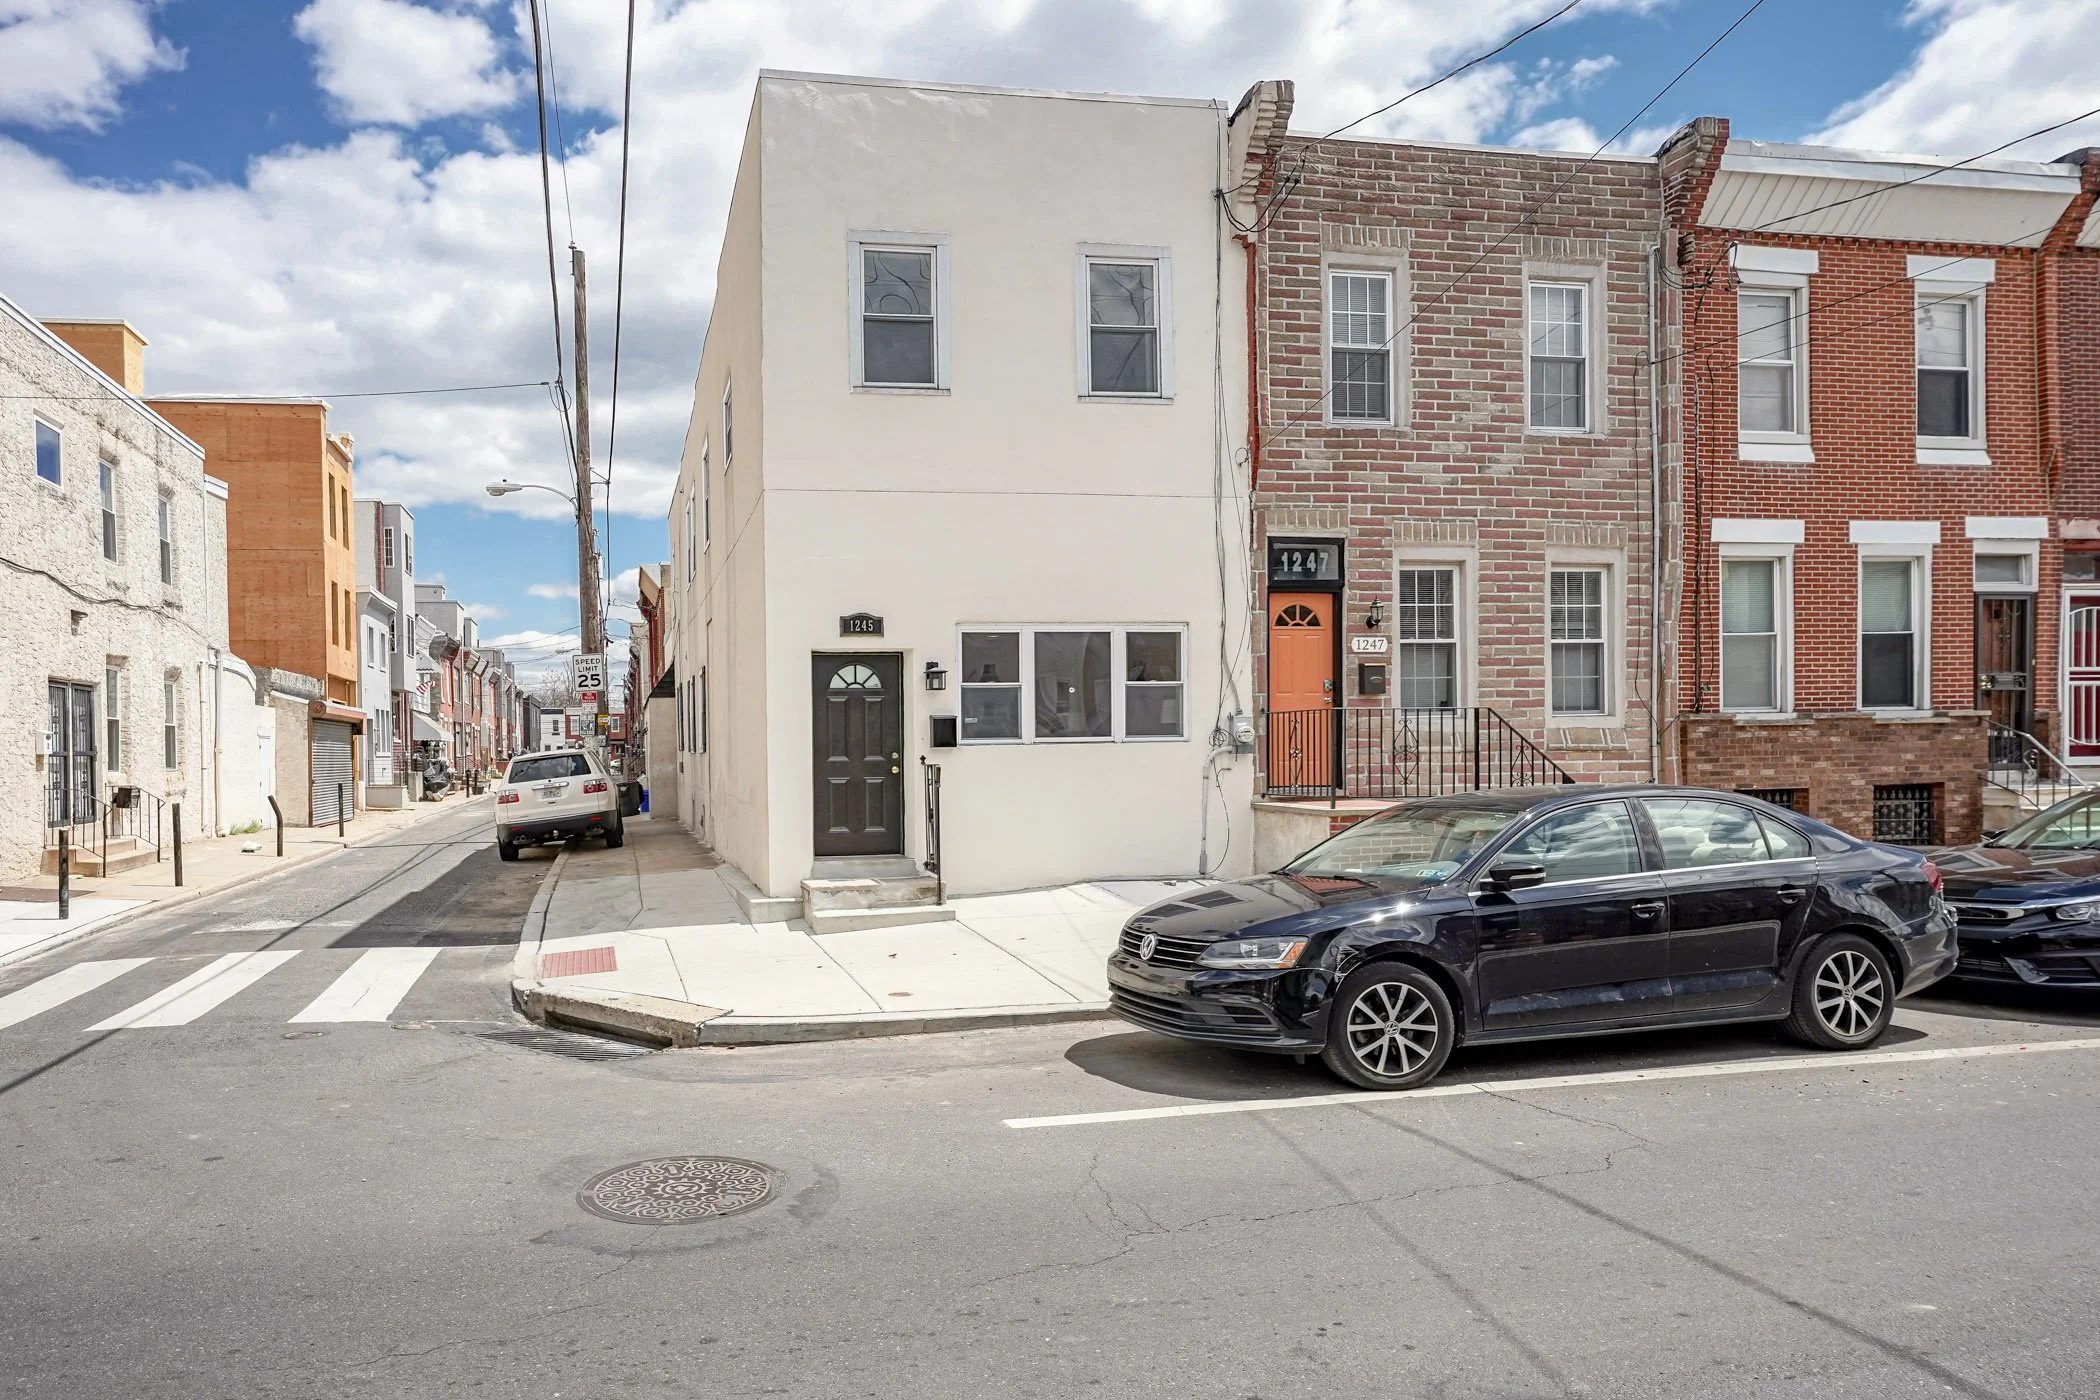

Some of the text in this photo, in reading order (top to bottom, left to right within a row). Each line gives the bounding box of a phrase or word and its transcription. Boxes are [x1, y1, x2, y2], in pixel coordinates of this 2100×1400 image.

[1281, 551, 1329, 572] 1247
[849, 619, 874, 632] 1245
[1355, 639, 1385, 651] 1247
[575, 657, 601, 666] SPEED
[577, 665, 599, 673] LIMIT
[578, 673, 602, 688] 25
